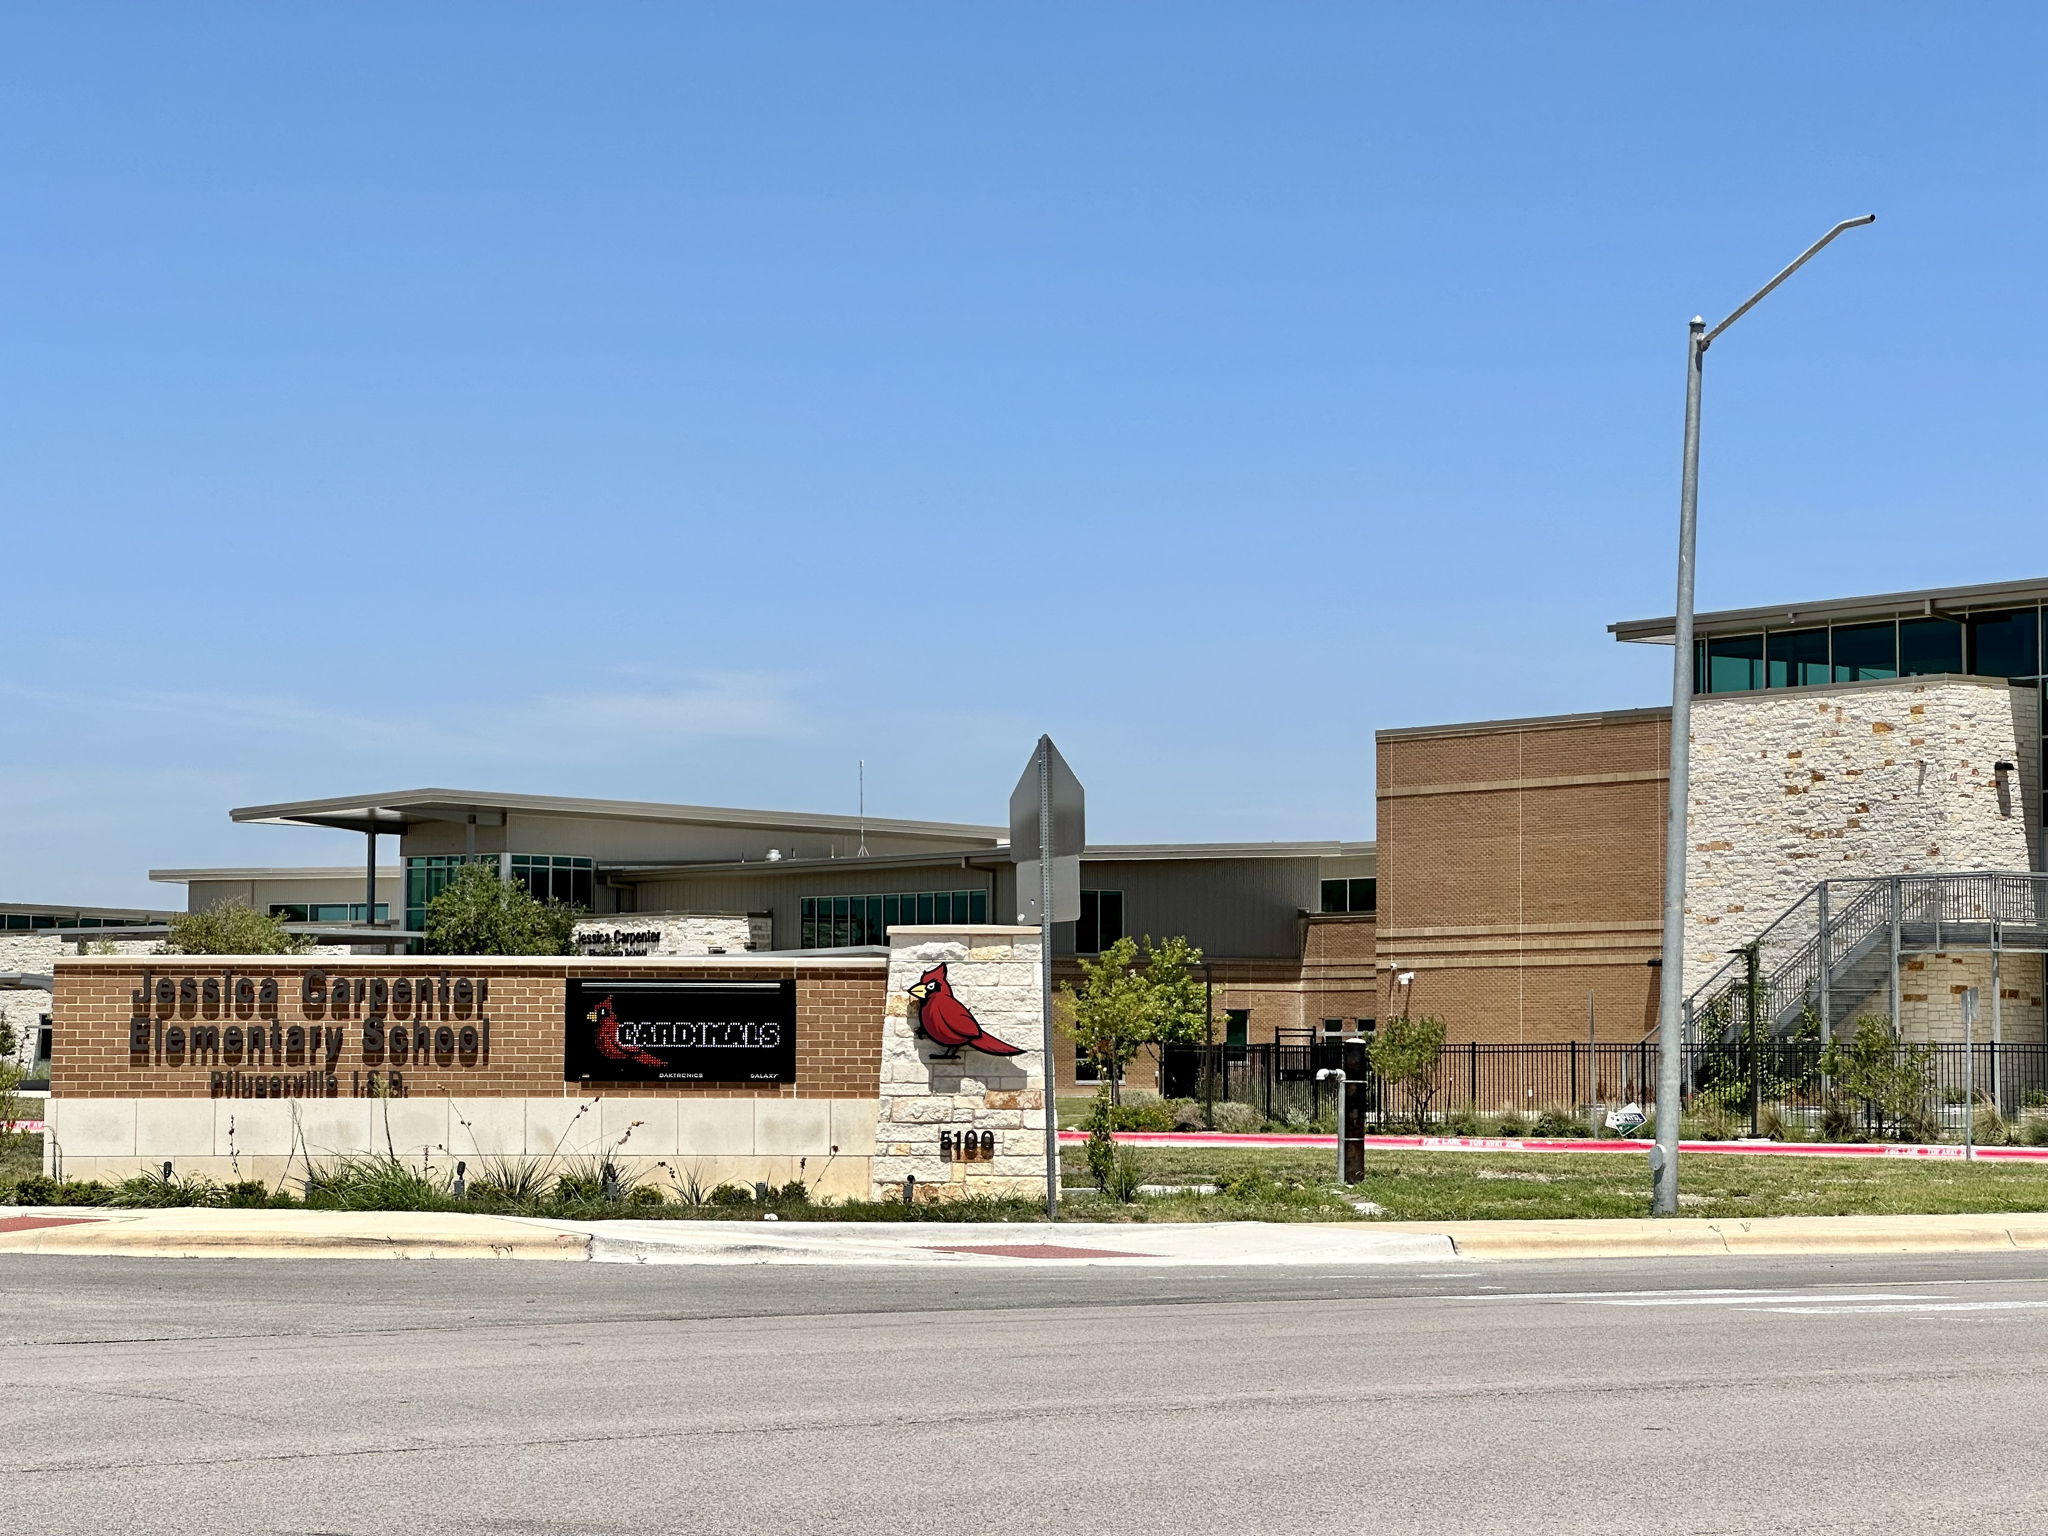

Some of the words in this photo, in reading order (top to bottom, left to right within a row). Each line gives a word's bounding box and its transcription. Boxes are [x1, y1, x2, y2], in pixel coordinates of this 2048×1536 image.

[613, 930, 661, 946] Carpenter
[132, 969, 278, 1003] Jessica
[302, 968, 488, 1012] Carpenter
[130, 1017, 343, 1061] Elementary
[362, 1016, 490, 1051] School
[617, 1022, 780, 1048] CARDINALS
[211, 1070, 338, 1098] Pflugerville
[940, 1130, 994, 1150] 5100
